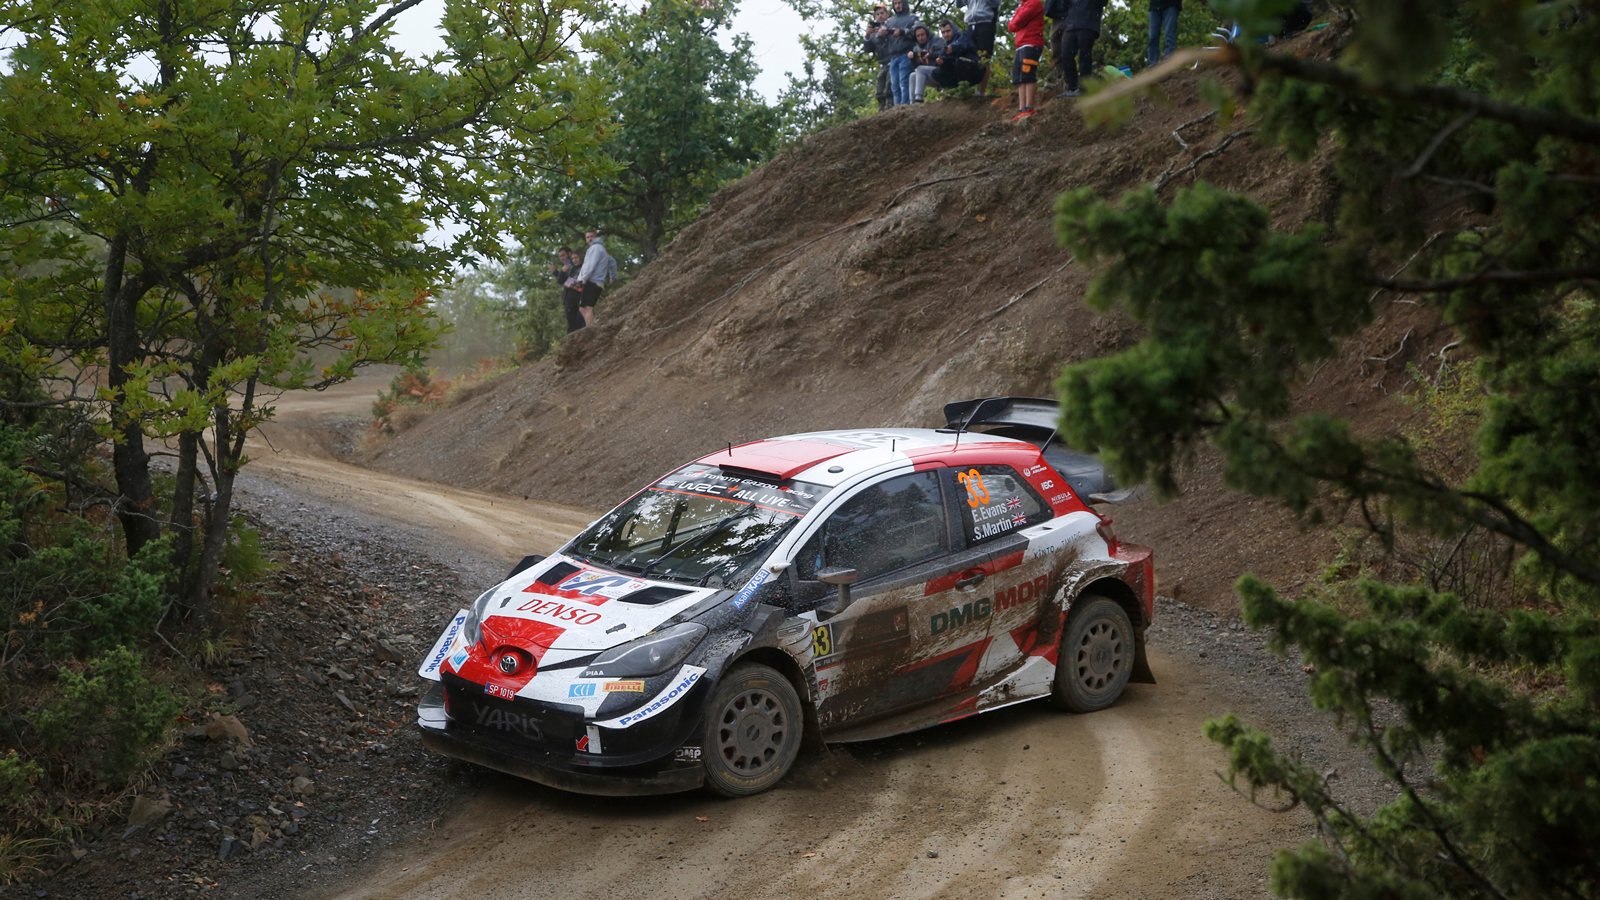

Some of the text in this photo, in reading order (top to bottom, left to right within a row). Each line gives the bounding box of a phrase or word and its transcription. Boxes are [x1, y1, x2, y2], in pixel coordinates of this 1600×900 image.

[703, 473, 814, 499] TOYOTA GAZOO Racing
[733, 489, 758, 501] ALL
[758, 494, 791, 507] LIVE
[957, 468, 990, 509] 33
[971, 502, 1008, 523] E.Evans
[973, 518, 1013, 540] S.Martin
[516, 599, 602, 625] DENSO
[930, 597, 990, 637] DMG
[424, 616, 466, 673] Panasonic
[488, 684, 515, 699] SP 1019
[605, 682, 642, 691] PIRELLI
[619, 672, 699, 726] Panasonic
